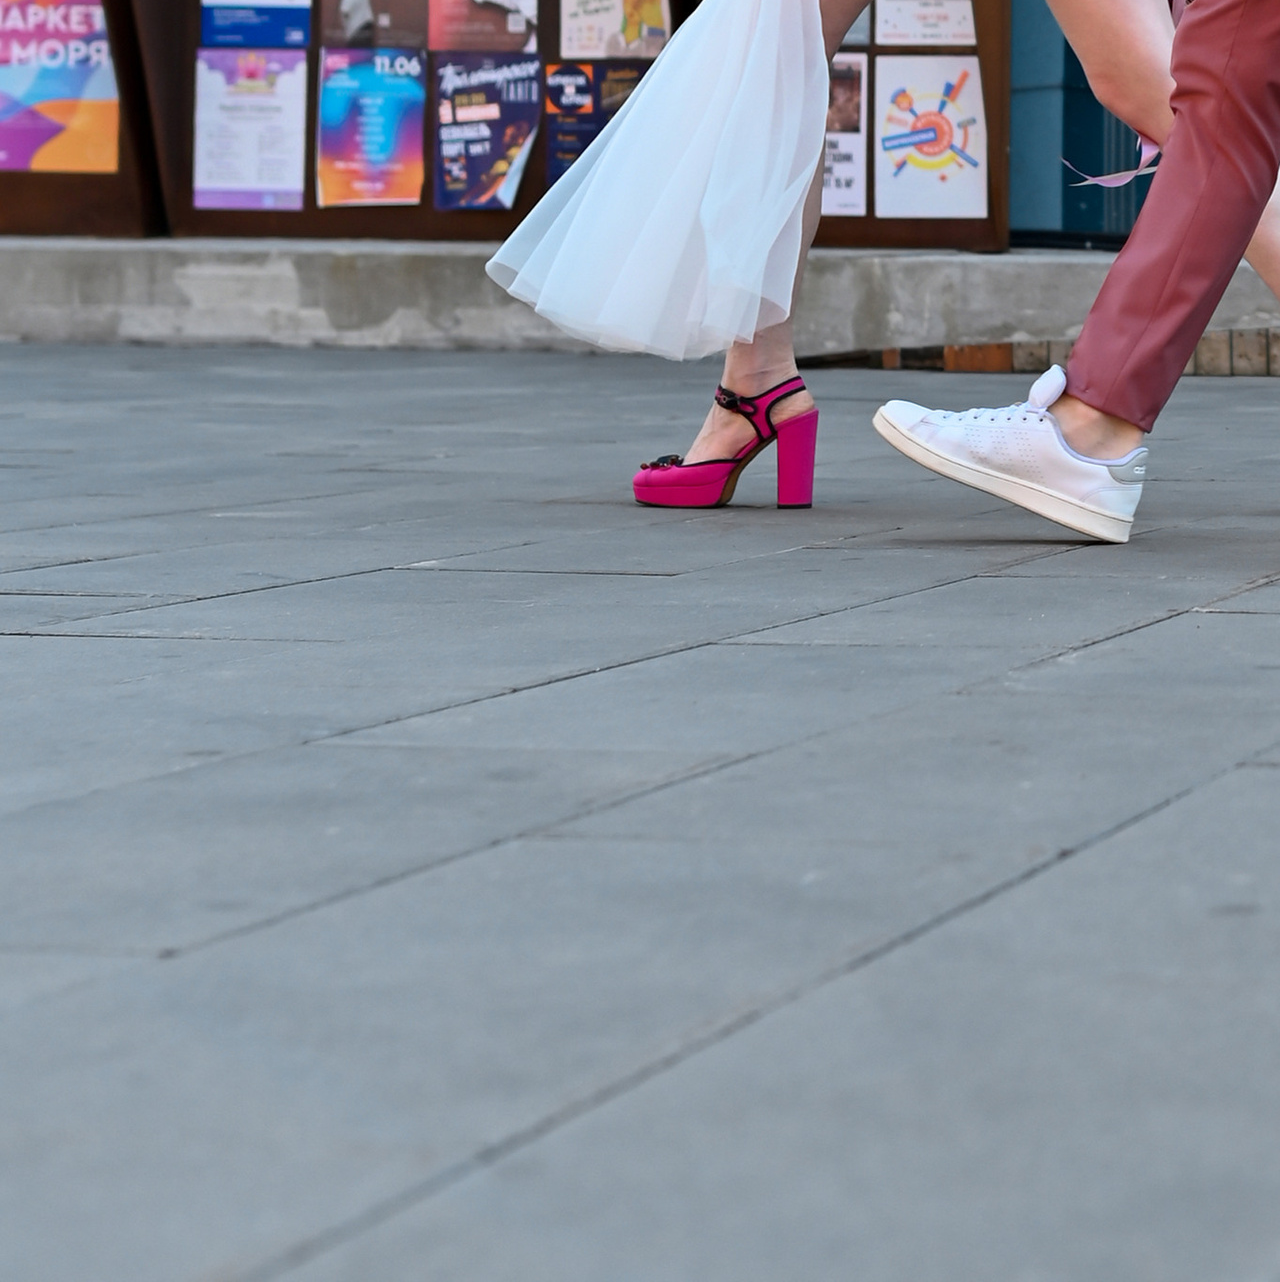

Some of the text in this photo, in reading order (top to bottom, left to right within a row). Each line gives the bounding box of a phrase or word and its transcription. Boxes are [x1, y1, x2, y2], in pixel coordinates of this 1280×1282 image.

[0, 4, 106, 34] АРКЕТ
[11, 38, 110, 68] МОРЯ
[374, 55, 422, 77] 11.06
